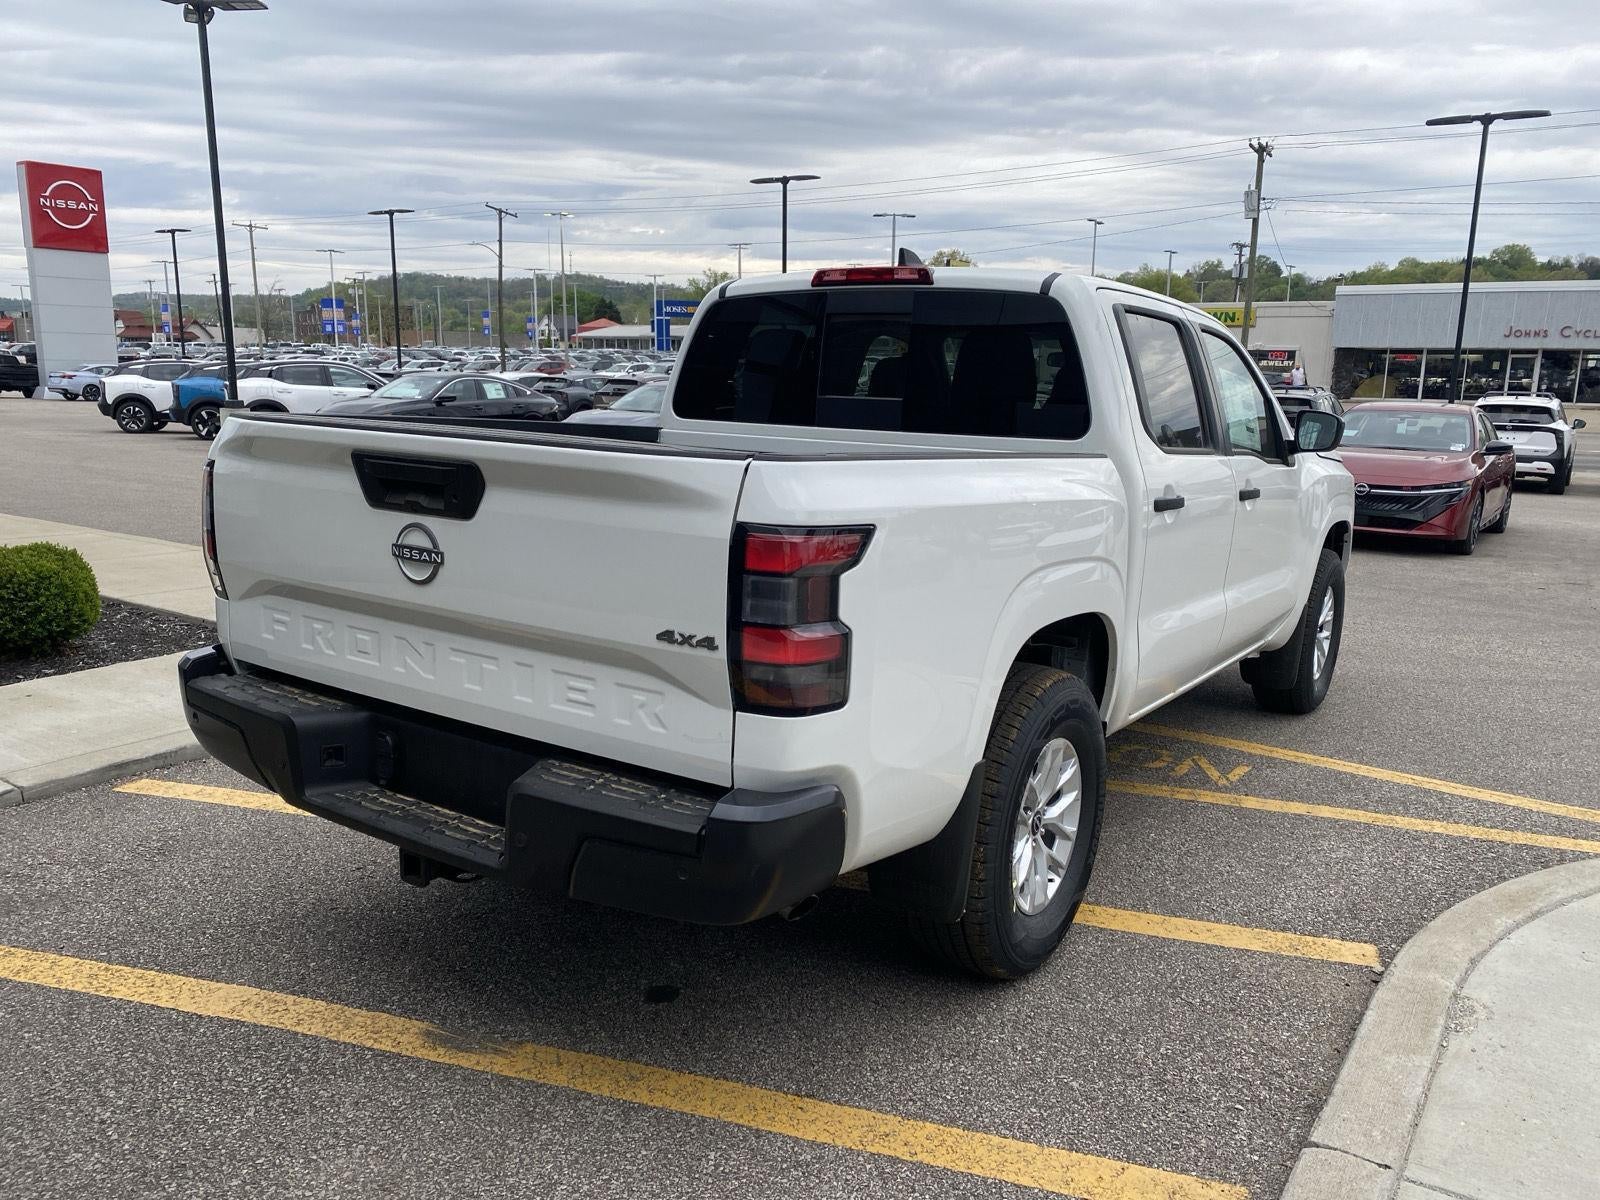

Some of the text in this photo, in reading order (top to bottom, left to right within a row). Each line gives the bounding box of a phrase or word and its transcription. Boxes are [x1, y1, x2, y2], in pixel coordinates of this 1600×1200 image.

[40, 197, 98, 211] NISSAN
[392, 546, 441, 563] NISSAN
[261, 604, 668, 733] FRONTIER
